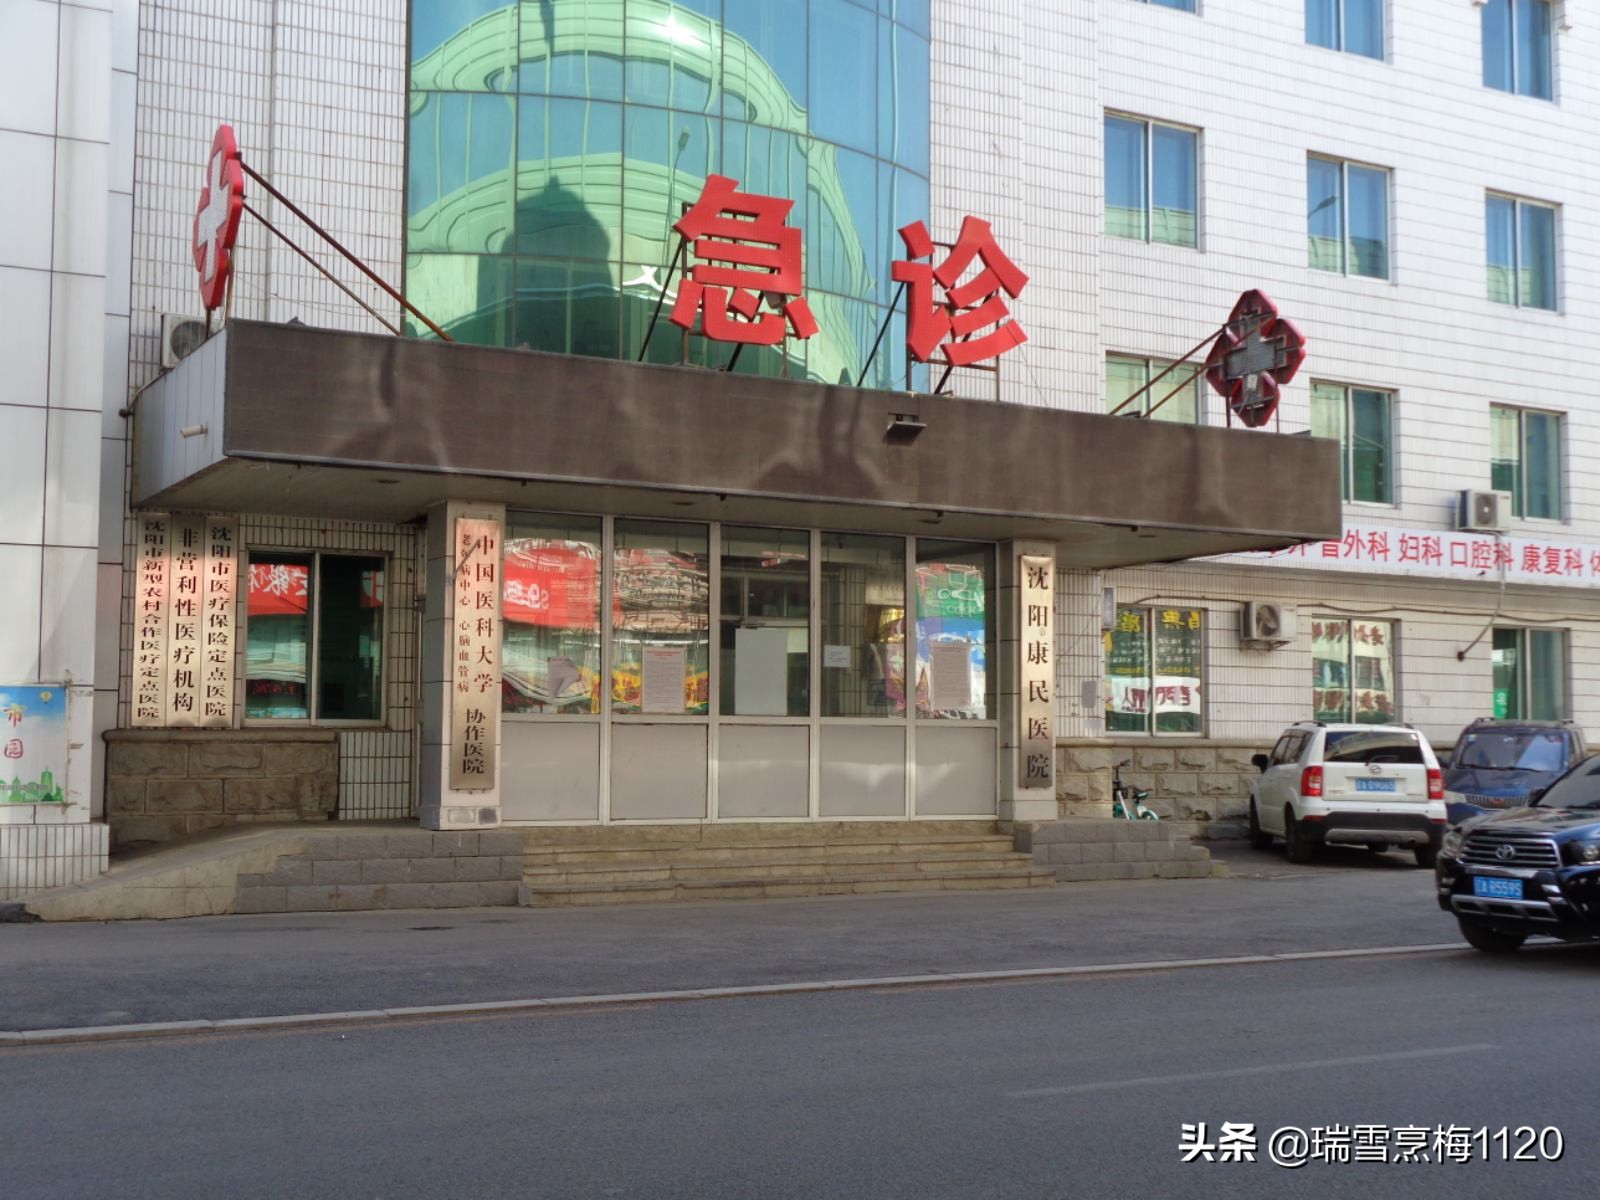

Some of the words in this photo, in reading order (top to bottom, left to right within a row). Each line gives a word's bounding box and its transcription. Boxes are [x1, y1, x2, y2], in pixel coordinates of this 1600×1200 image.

[669, 174, 1030, 367] 急诊
[138, 520, 165, 718] 沈阳市新型农村合作医疗定点医院
[172, 528, 199, 712] 非营利性医疗机构
[205, 526, 232, 717] 沈阳市医疗保险定点医院
[473, 534, 495, 694] 中国医科大学
[1398, 533, 1443, 567] 妇科
[1450, 540, 1514, 571] 口腔科
[1521, 544, 1583, 577] 康复科
[462, 708, 486, 775] 协作医院
[1026, 566, 1050, 779] 沈阳康民医院
